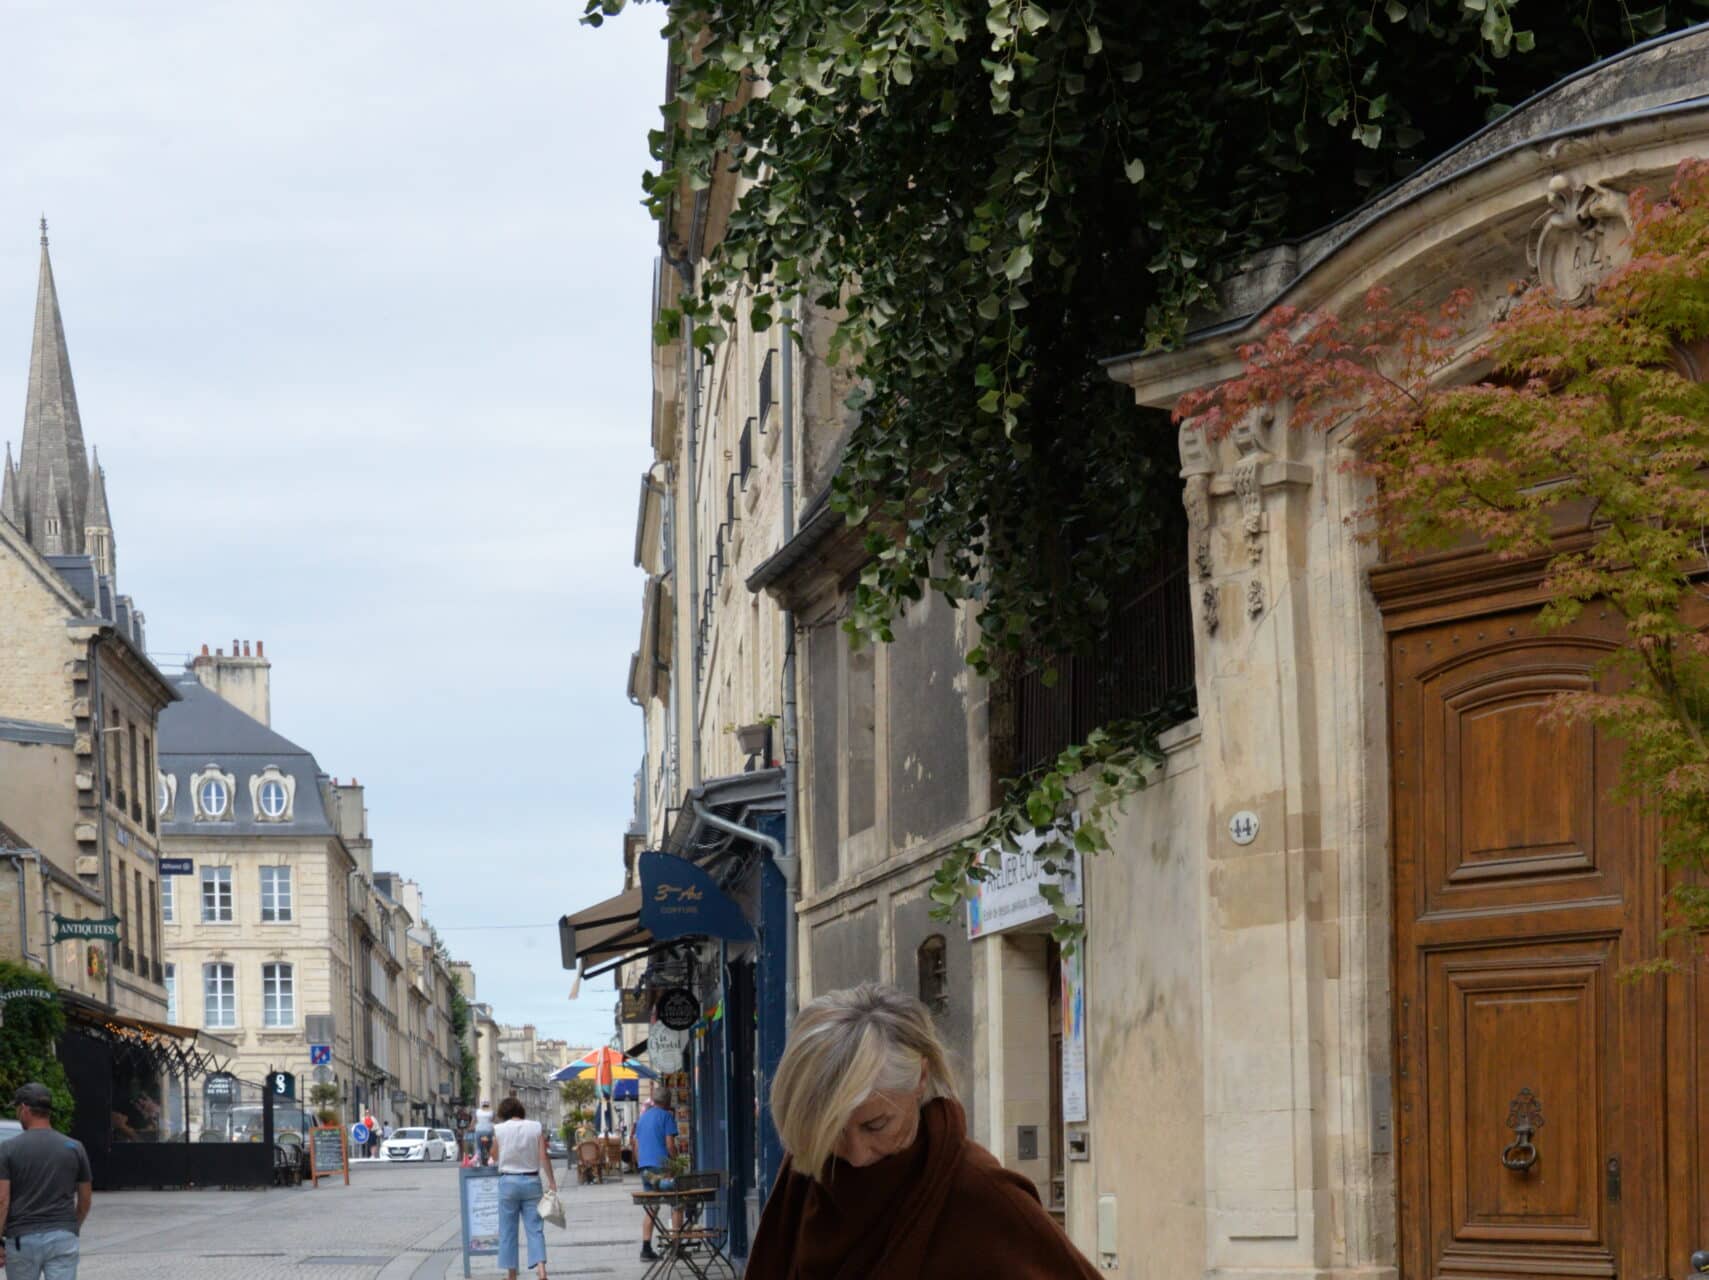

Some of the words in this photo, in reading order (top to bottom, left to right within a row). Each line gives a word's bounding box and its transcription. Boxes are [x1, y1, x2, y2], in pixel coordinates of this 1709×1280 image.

[1234, 817, 1252, 838] 44
[61, 923, 114, 936] ANTIQUITES
[0, 989, 51, 1000] NTIQUITES
